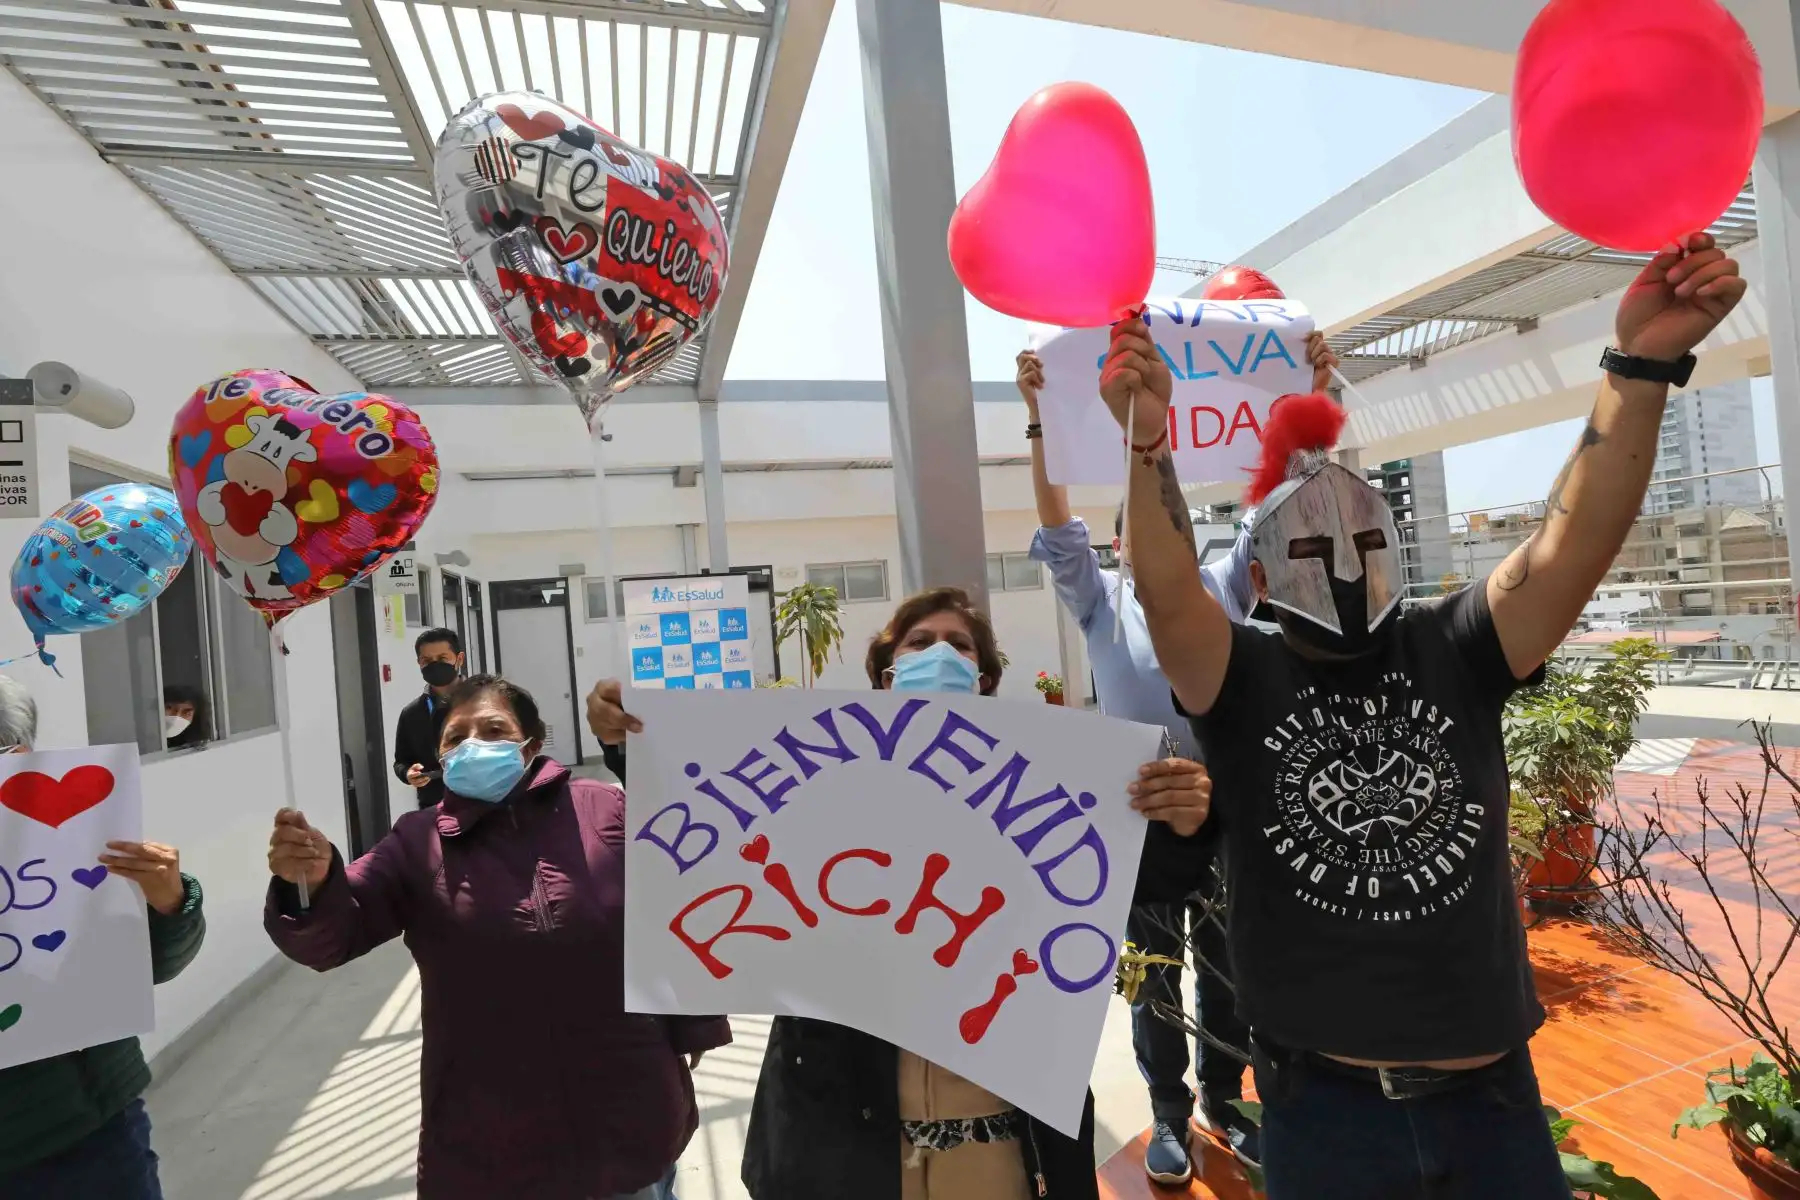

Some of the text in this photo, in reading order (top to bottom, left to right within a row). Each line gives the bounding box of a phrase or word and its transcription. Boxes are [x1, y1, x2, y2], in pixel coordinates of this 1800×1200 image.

[510, 142, 604, 213] Te
[605, 207, 713, 303] Quiero
[1110, 301, 1294, 328] NAR
[206, 377, 252, 402] Te
[1168, 394, 1290, 451] IDA
[677, 587, 724, 602] EsSalud
[1406, 699, 1454, 734] VST
[1345, 875, 1380, 899] OF
